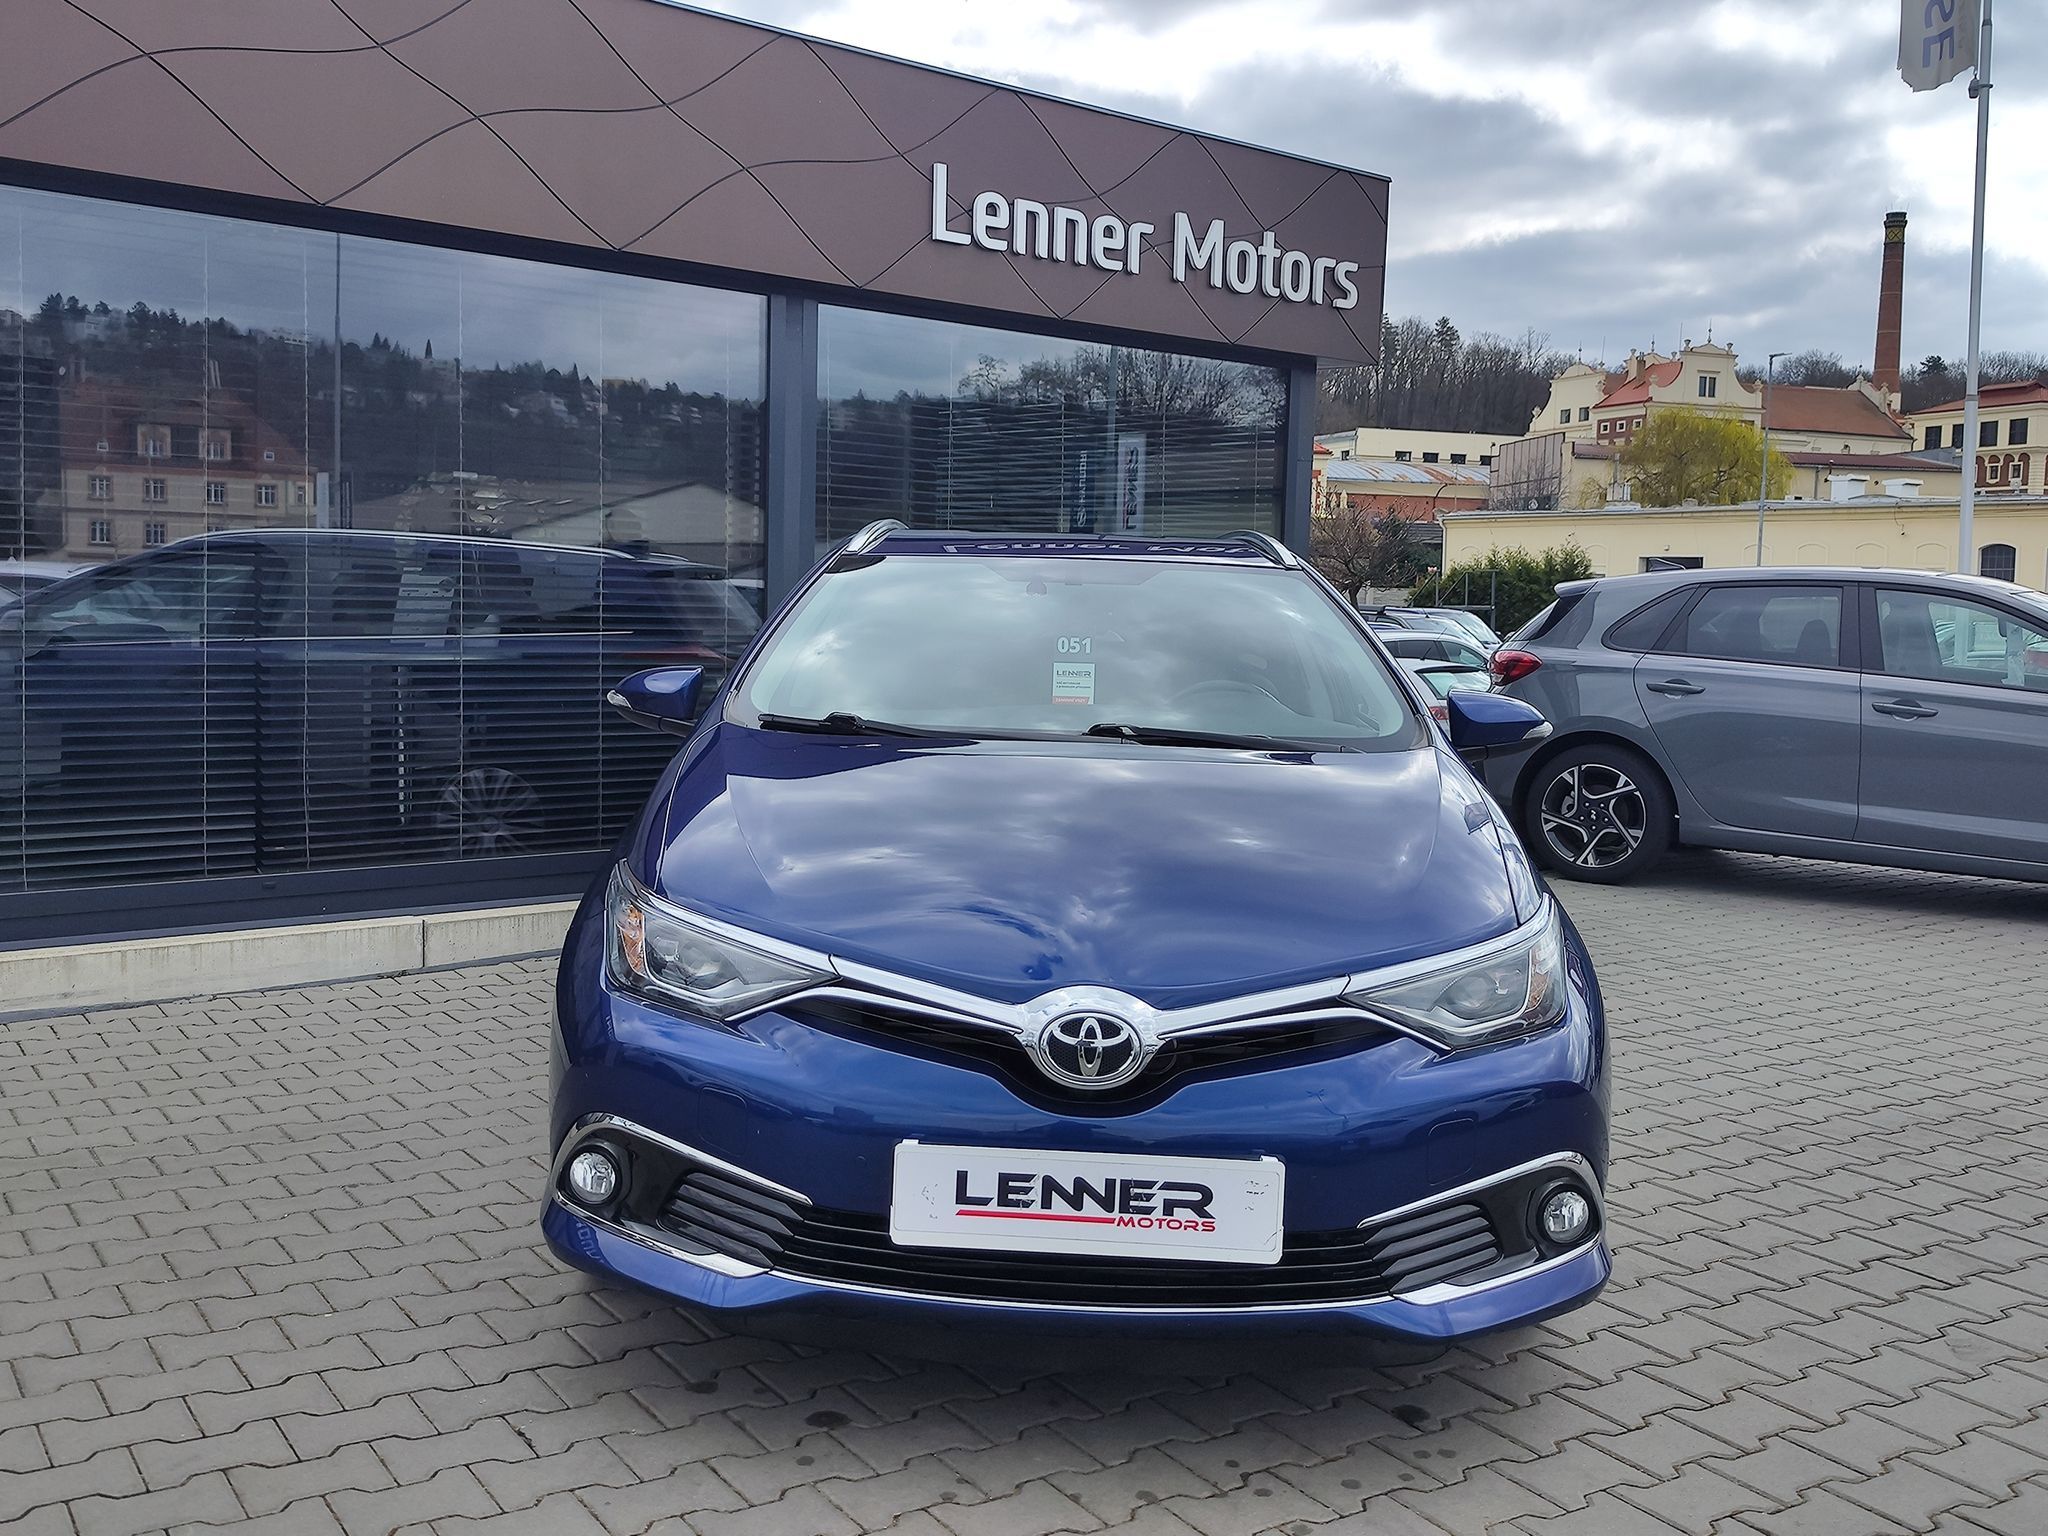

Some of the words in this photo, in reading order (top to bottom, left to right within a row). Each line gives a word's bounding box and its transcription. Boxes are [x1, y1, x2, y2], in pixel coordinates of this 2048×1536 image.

[932, 162, 1155, 275] Lenner
[1173, 211, 1360, 310] Motors
[1057, 636, 1092, 654] 051
[955, 1170, 1216, 1219] LENNER
[1116, 1216, 1216, 1232] MOTORS
